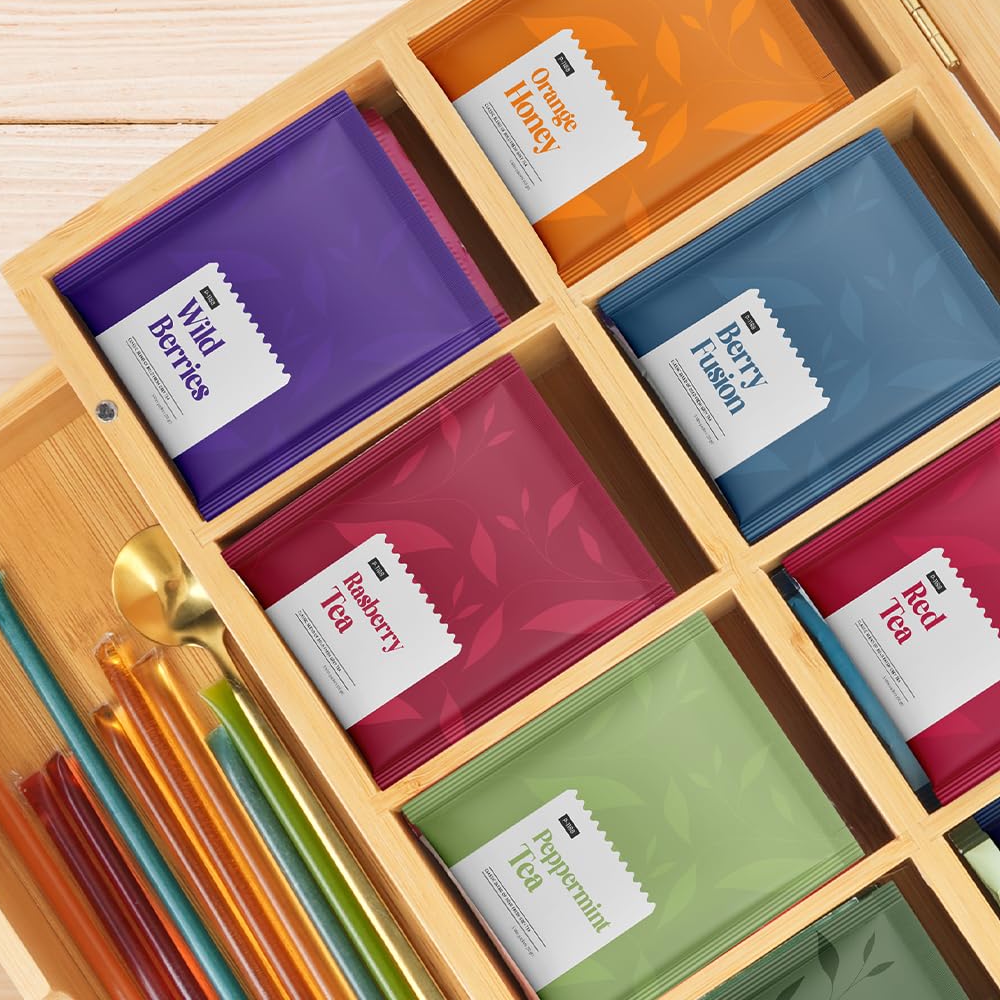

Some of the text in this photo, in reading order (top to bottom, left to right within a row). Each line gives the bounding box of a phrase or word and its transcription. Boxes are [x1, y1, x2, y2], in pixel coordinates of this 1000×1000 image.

[504, 80, 560, 154] Honey
[531, 68, 577, 132] Orange
[147, 313, 209, 401] Berries
[177, 296, 226, 357] Wild
[715, 321, 768, 389] Berry
[690, 337, 745, 416] Fusion
[320, 585, 353, 634] Tea
[342, 571, 404, 653] Rasberry
[878, 597, 912, 645] Tea
[901, 580, 947, 632] Red
[508, 843, 543, 893] Tea
[532, 828, 611, 933] Peppermint
